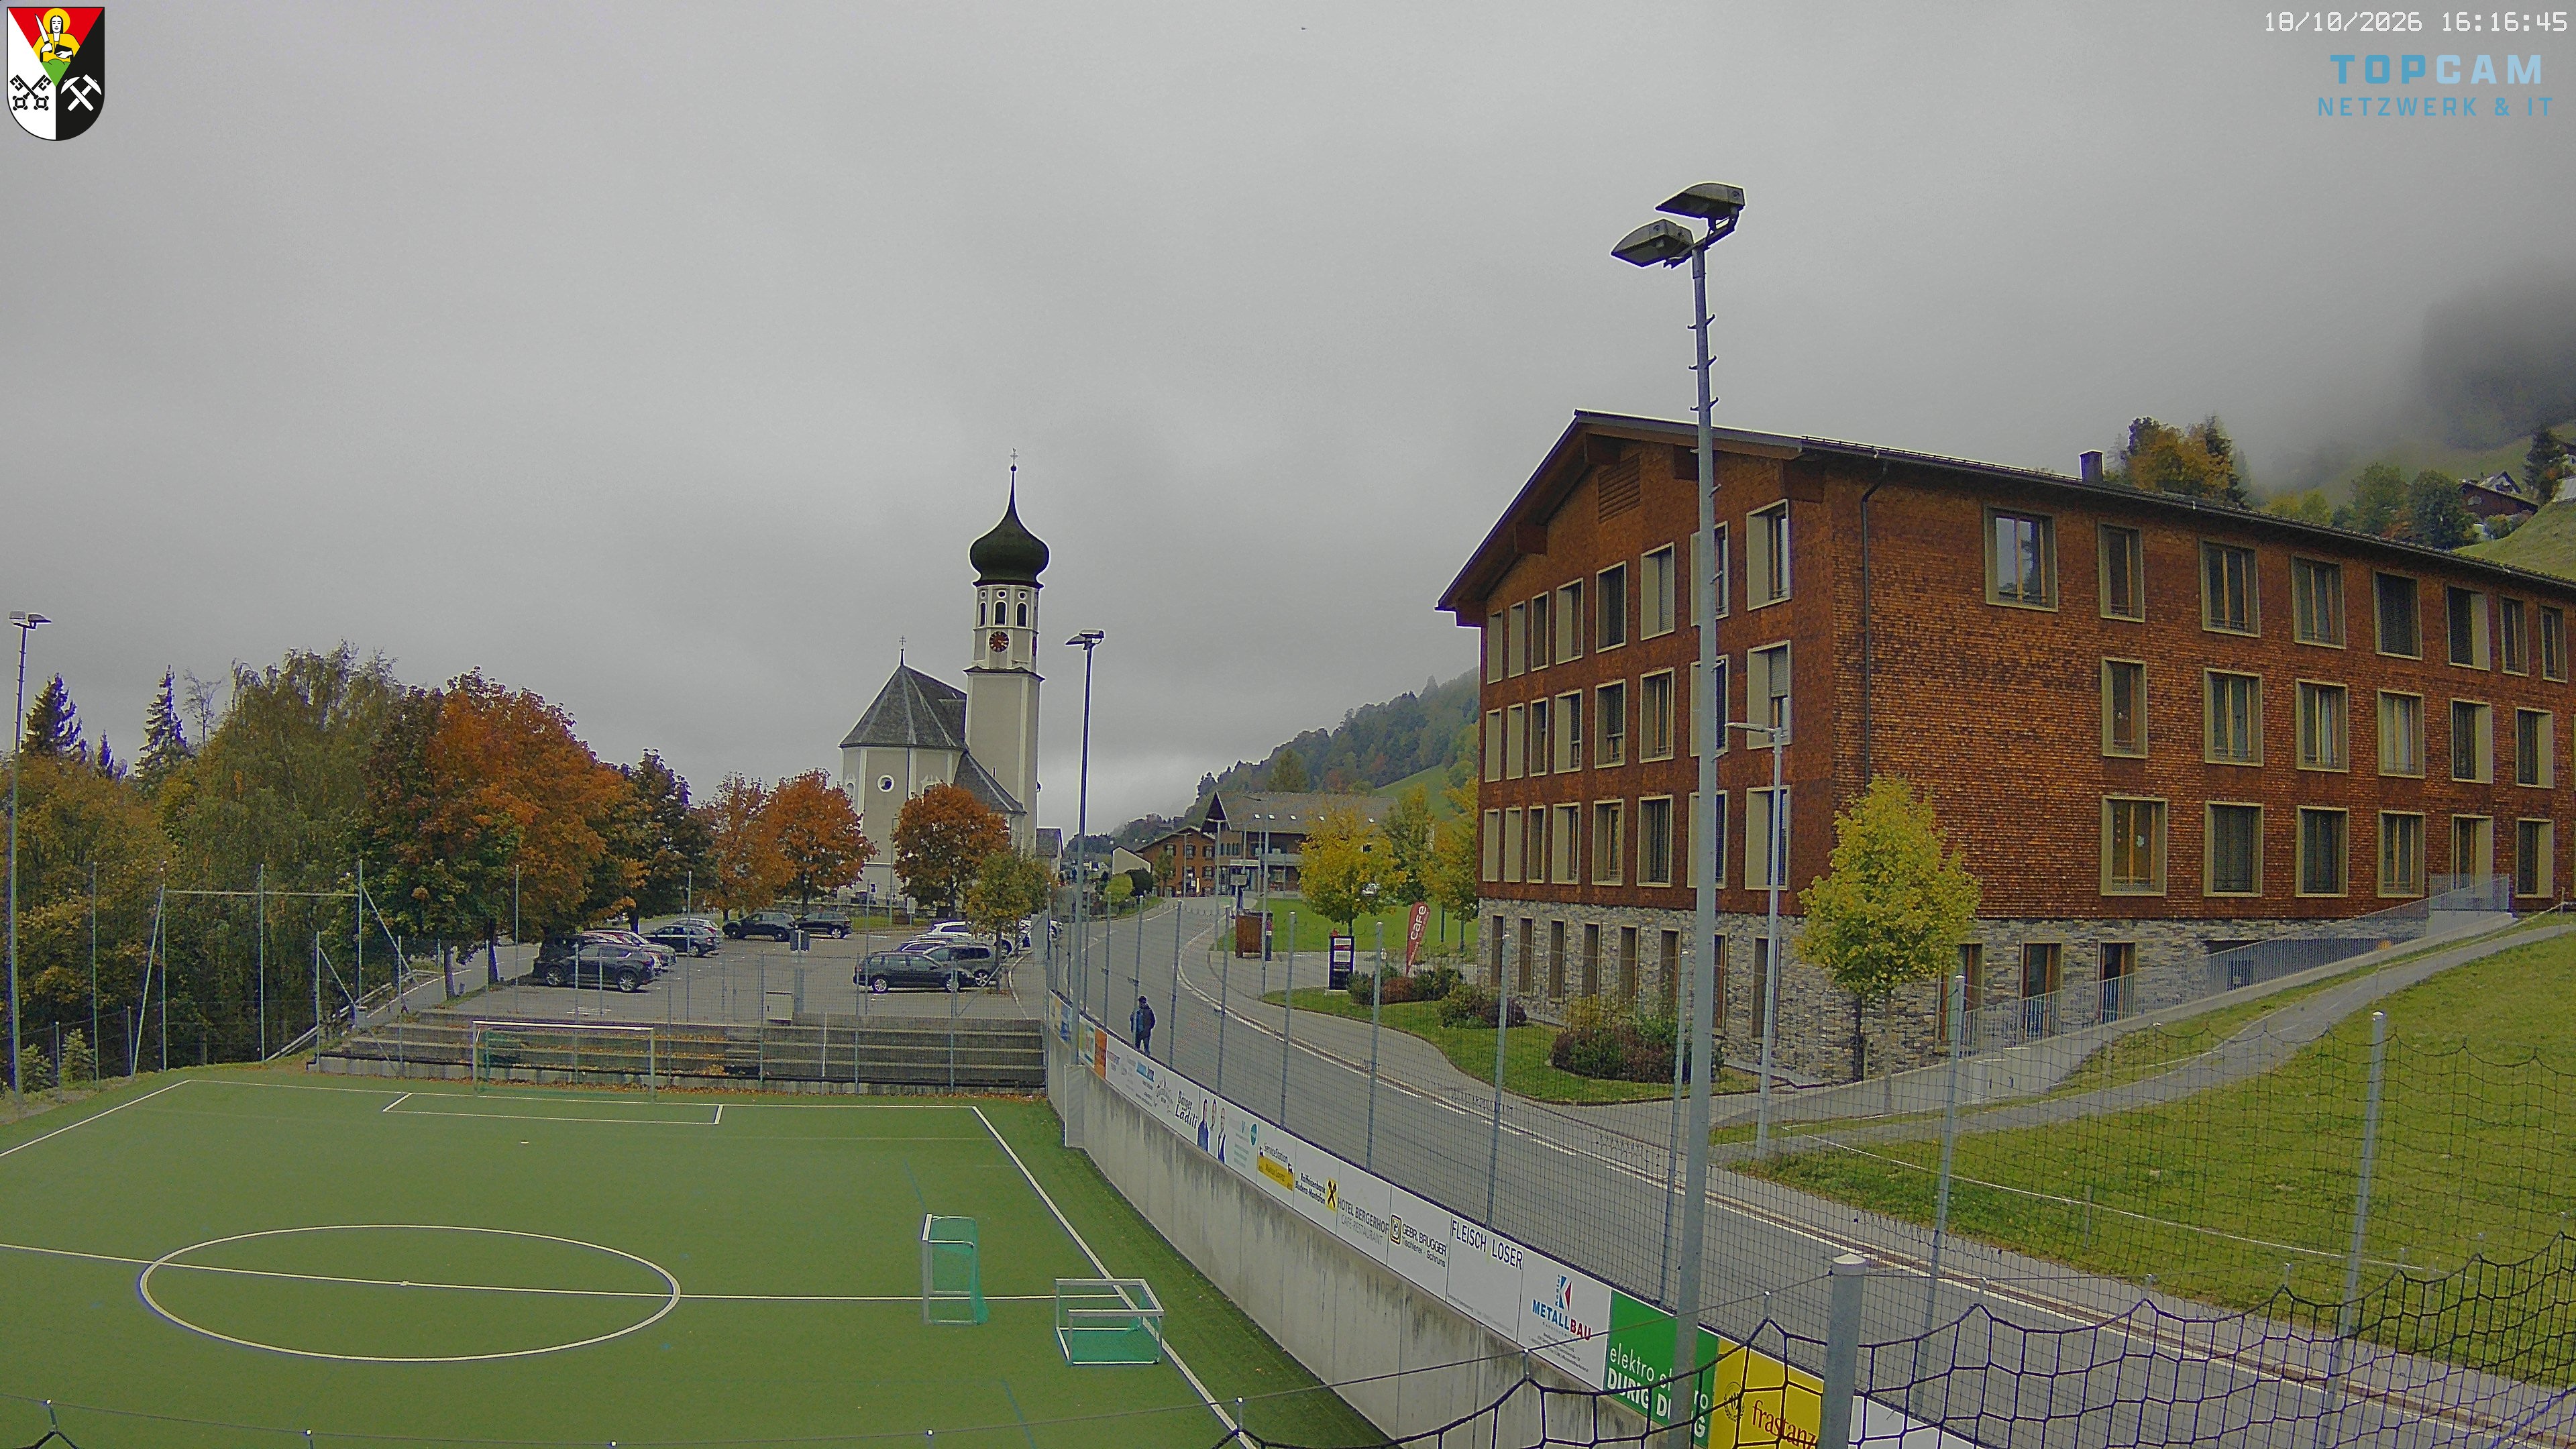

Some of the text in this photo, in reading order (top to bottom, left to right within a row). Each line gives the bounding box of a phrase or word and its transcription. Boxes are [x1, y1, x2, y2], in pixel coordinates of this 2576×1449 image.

[1337, 1197, 1389, 1235] HOTEL BERGERHOF
[1402, 1223, 1418, 1240] GEBR.
[1426, 1250, 1446, 1268] Schruns
[1451, 1219, 1523, 1270] FLEISCH LOSER
[1532, 1298, 1592, 1341] METALLBAU
[1610, 1342, 1655, 1382] elektro
